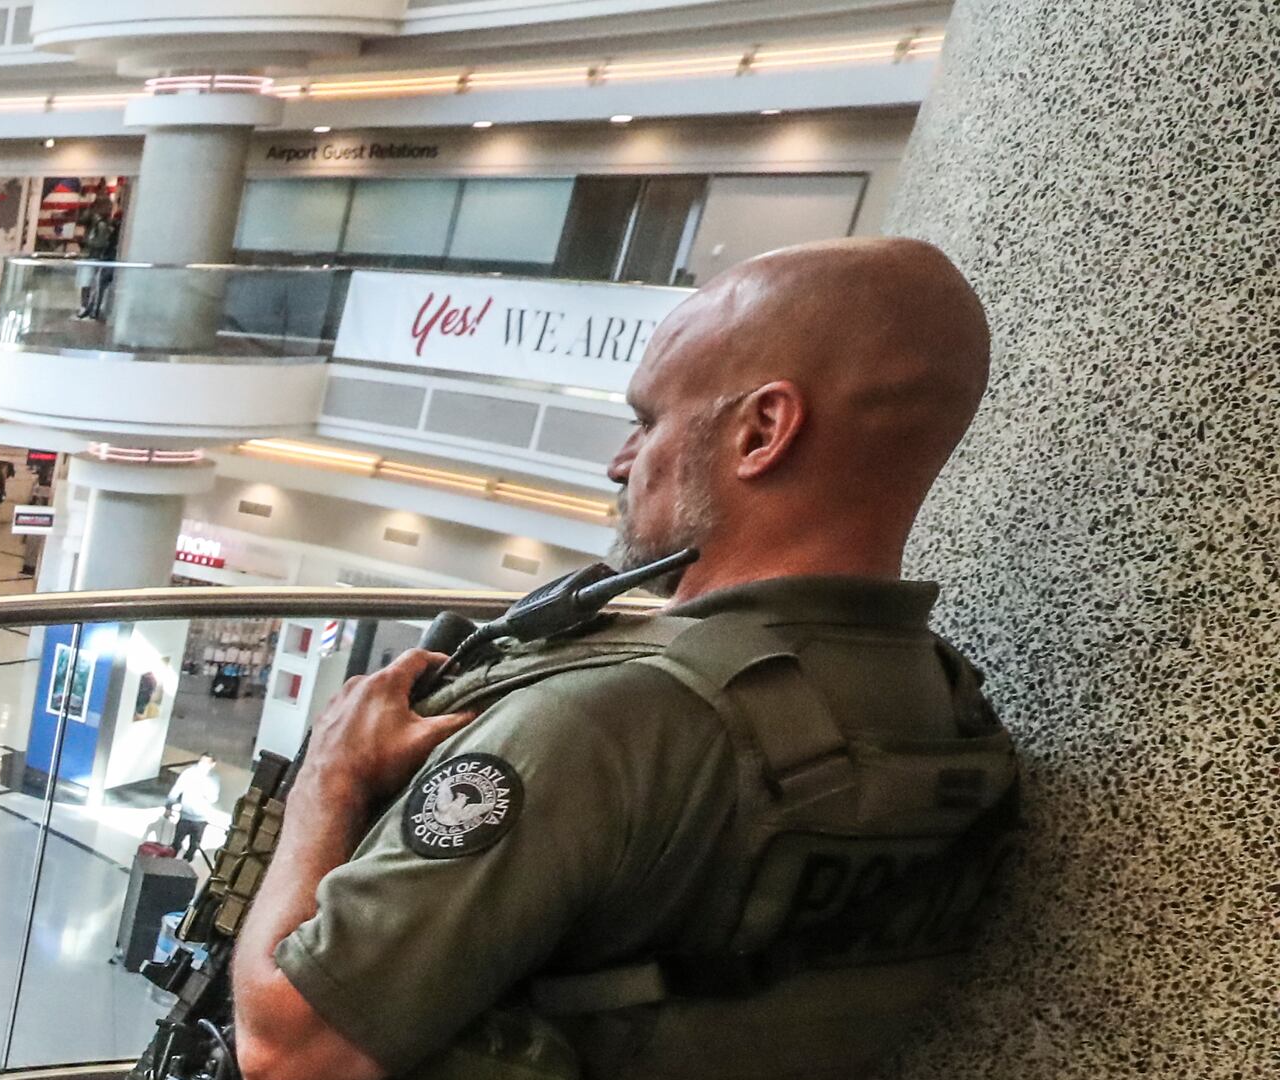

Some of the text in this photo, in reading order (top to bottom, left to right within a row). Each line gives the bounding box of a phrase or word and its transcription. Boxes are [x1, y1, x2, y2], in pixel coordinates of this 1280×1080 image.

[266, 143, 439, 162] Airport Guest Relations
[411, 291, 494, 358] Yes!
[503, 306, 565, 354] WE
[422, 766, 453, 794] CITY
[456, 761, 481, 773] OF
[478, 765, 511, 825] ATLANTA
[410, 812, 465, 848] POLICE
